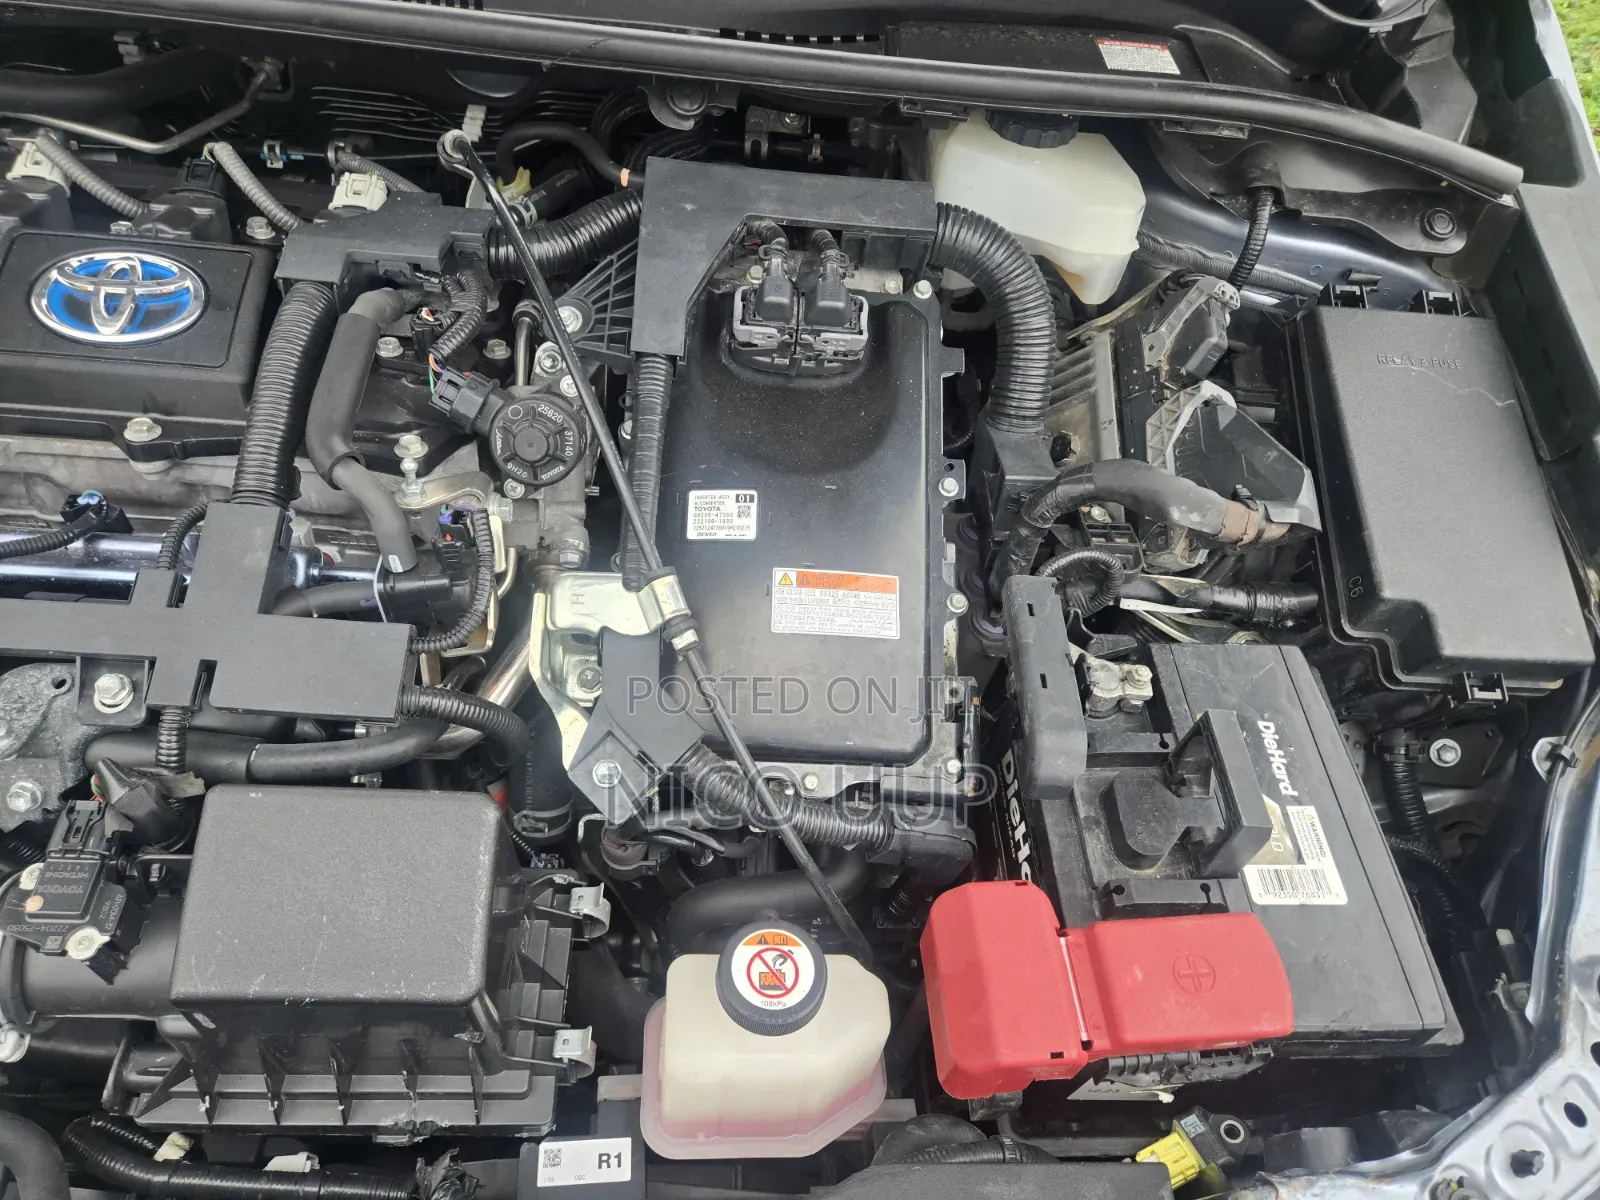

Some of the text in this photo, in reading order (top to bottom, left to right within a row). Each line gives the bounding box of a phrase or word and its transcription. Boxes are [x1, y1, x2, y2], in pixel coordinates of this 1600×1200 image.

[1376, 353, 1462, 370] RELAY & FUSE
[537, 403, 563, 423] 25620
[564, 430, 574, 457] 37140
[506, 462, 528, 479] 9H20
[540, 465, 565, 481] TOYOTA
[738, 494, 750, 503] 01
[1257, 720, 1299, 798] DieHard
[37, 884, 84, 894] TOYOTA
[1271, 891, 1298, 899] 92350
[760, 1000, 787, 1008] 108kPa
[597, 1152, 623, 1170] R1
